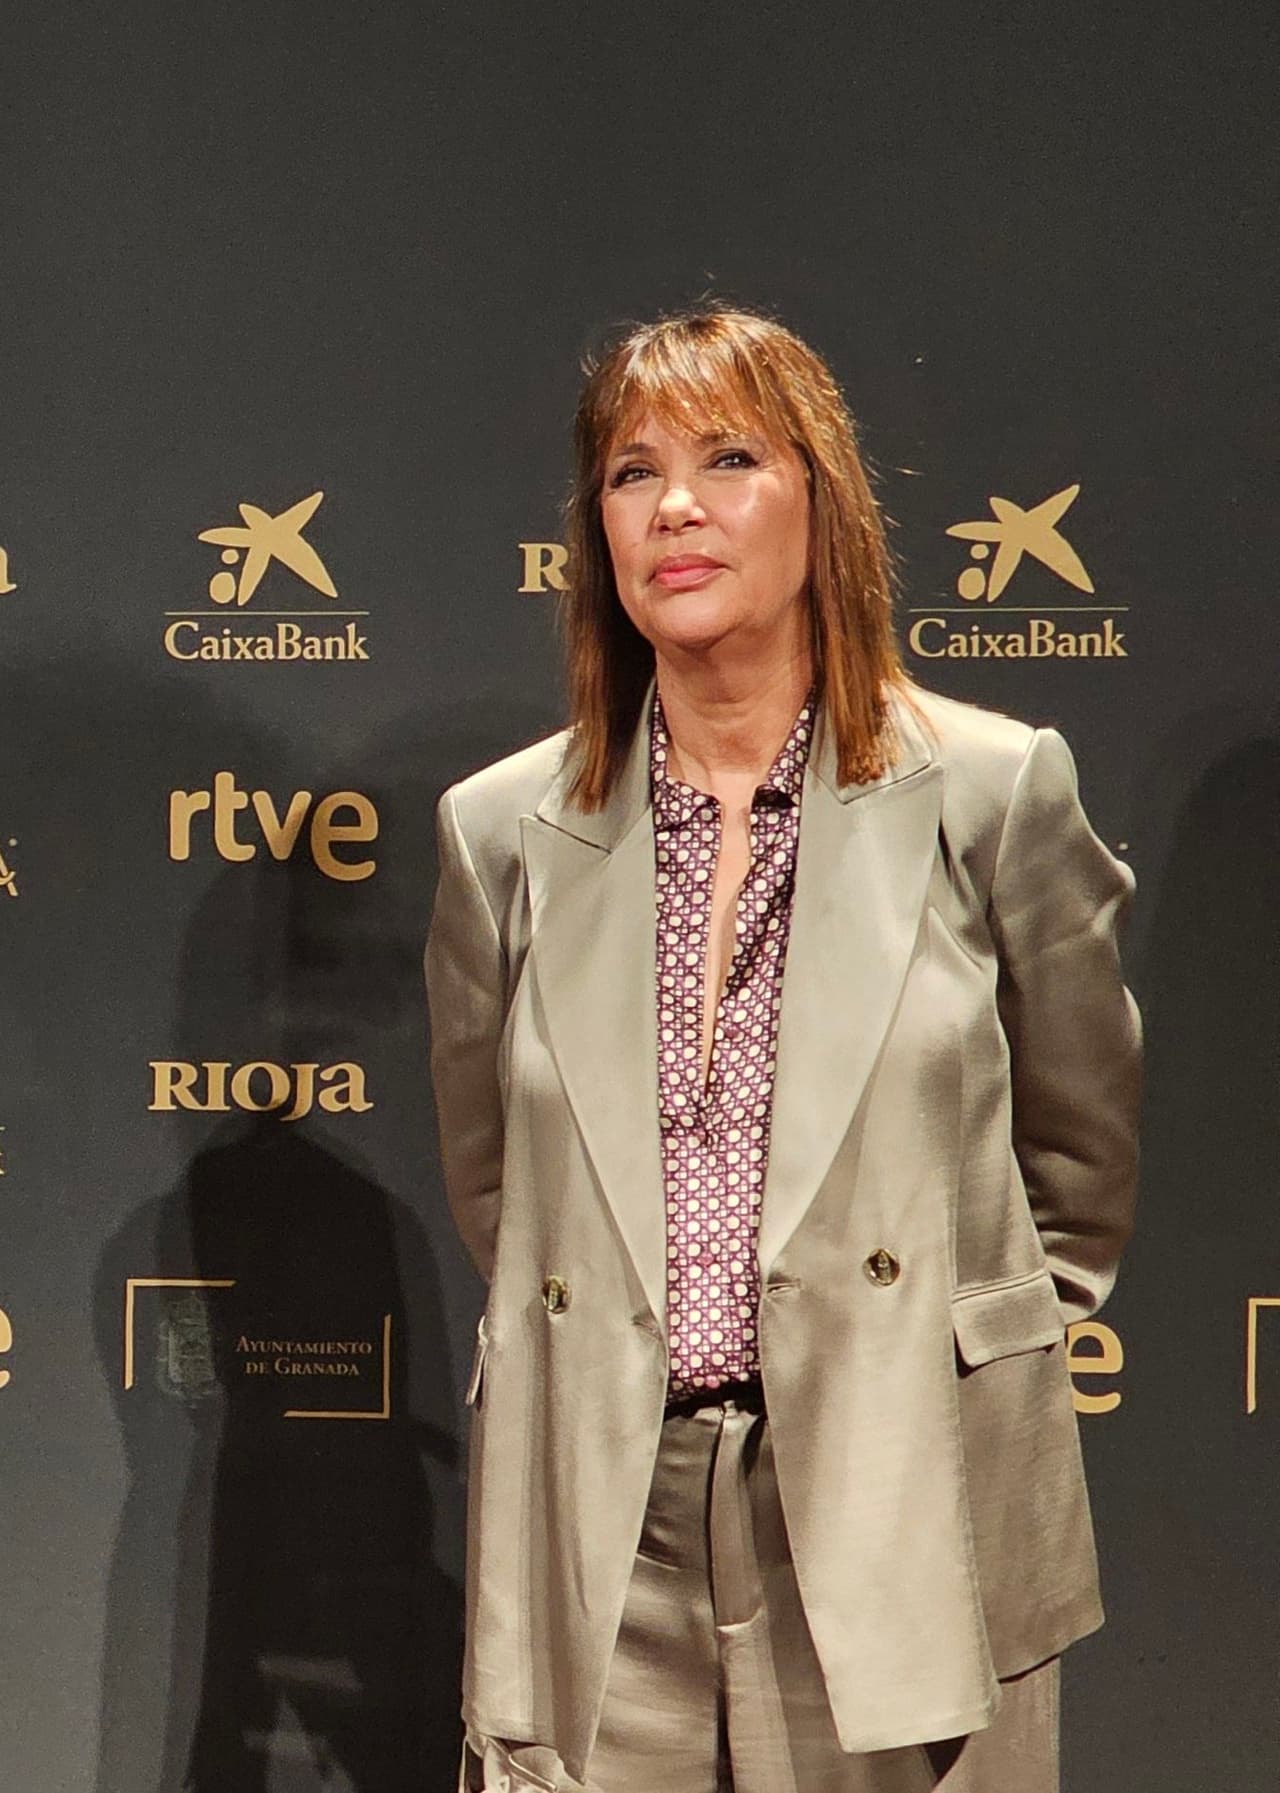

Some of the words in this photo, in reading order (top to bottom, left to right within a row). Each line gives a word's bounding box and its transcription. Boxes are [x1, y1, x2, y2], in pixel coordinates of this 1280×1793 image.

[163, 620, 370, 661] CaixaBank
[909, 617, 1128, 659] CaixaBank
[168, 770, 379, 882] rtve
